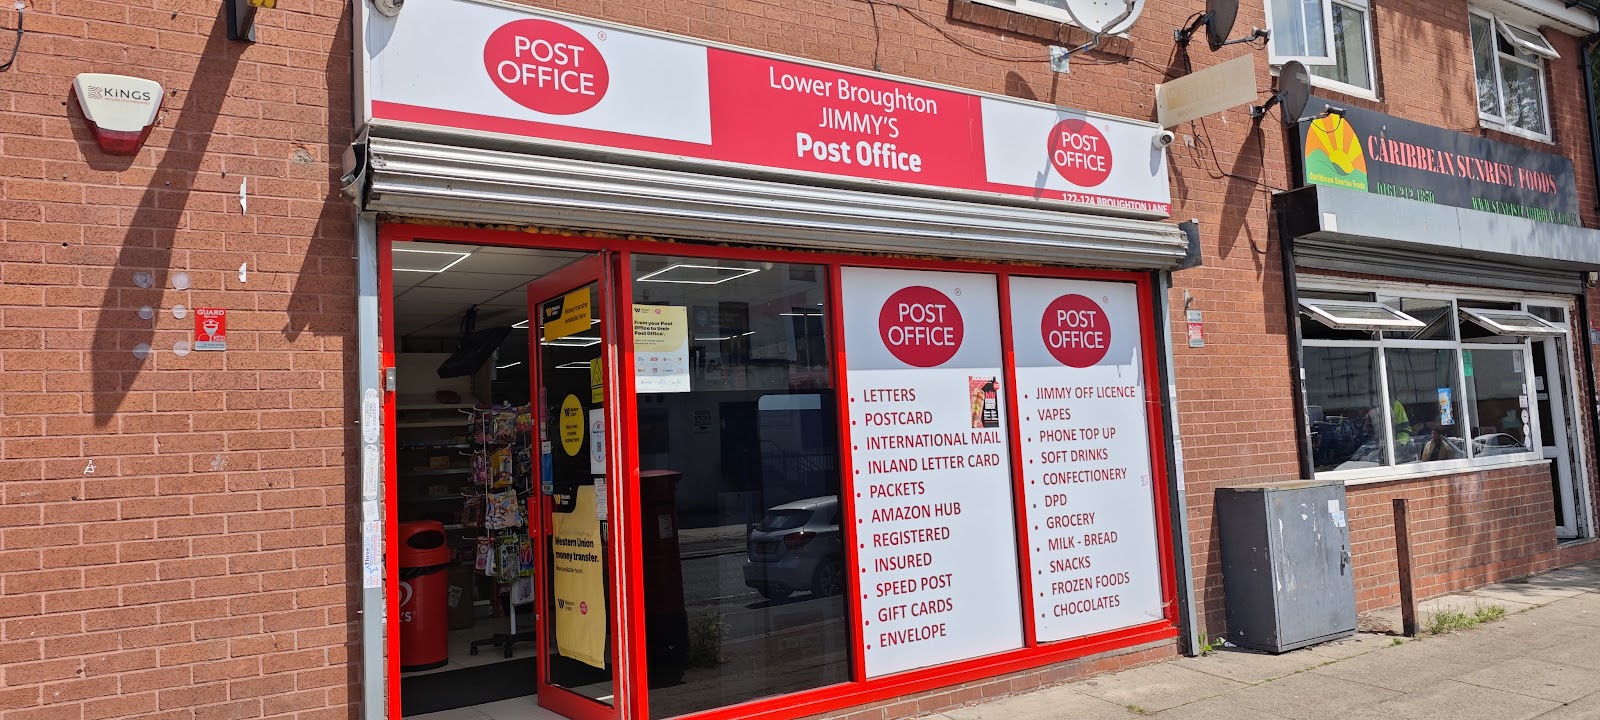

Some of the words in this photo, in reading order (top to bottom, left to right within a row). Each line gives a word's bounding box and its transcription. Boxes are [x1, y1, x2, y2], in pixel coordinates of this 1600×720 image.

[514, 35, 584, 68] POST
[497, 60, 596, 96] OFFICE
[769, 65, 834, 98] Lower
[837, 77, 938, 115] Broughton
[818, 107, 899, 138] JIMMY'S
[796, 132, 851, 164] Post
[856, 141, 922, 173] Office
[1061, 131, 1099, 153] POST
[1054, 149, 1106, 173] OFFICE
[1367, 135, 1455, 176] CARIBBEAN
[1456, 154, 1516, 187] SUNRISE
[1518, 167, 1557, 194] FOODS
[1062, 193, 1094, 205] 122-124
[1096, 197, 1146, 211] BROUGHTON
[1148, 204, 1168, 213] LANE
[898, 303, 946, 323] POST
[1056, 309, 1096, 328] POST
[888, 325, 955, 346] OFFICE
[1048, 330, 1104, 349] OFFICE
[863, 388, 916, 403] LETTERS
[1035, 387, 1072, 400] JIMMY
[1075, 387, 1094, 399] OFF
[1096, 386, 1136, 398] LICENCE
[865, 411, 933, 426] POSTCARD
[1037, 408, 1071, 421] VAPES
[866, 432, 968, 450] INTERNATIONAL
[971, 431, 1001, 445] MAIL
[1039, 428, 1076, 443] PHONE
[1079, 427, 1100, 440] TOP
[1102, 427, 1116, 439] UP
[868, 458, 918, 475] INLAND
[921, 455, 964, 471] LETTER
[967, 453, 1000, 468] CARD
[1041, 450, 1067, 465] SOFT
[1070, 448, 1108, 462] DRINKS
[1043, 467, 1127, 486] CONFECTIONERY
[869, 481, 925, 499] PACKETS
[1044, 493, 1067, 508] DPD
[871, 504, 931, 523] AMAZON
[934, 502, 962, 517] HUB
[1046, 512, 1095, 529] GROCERY
[555, 536, 576, 547] Western
[576, 538, 594, 548] Union
[873, 526, 950, 548] REGISTERED
[1048, 535, 1075, 552] MILK
[1084, 531, 1118, 547] BREAD
[555, 551, 572, 562] money
[573, 552, 599, 562] transfer.
[874, 552, 932, 573] INSURED
[1049, 555, 1091, 573] SNACKS
[876, 579, 917, 598] SPEED
[920, 573, 953, 591] POST
[1051, 577, 1093, 596] FROZEN
[1095, 571, 1130, 589] FOODS
[878, 604, 907, 622] GIFT
[911, 597, 953, 617] CARDS
[1053, 594, 1120, 618] CHOCOLATES
[879, 623, 947, 648] ENVELOPE
